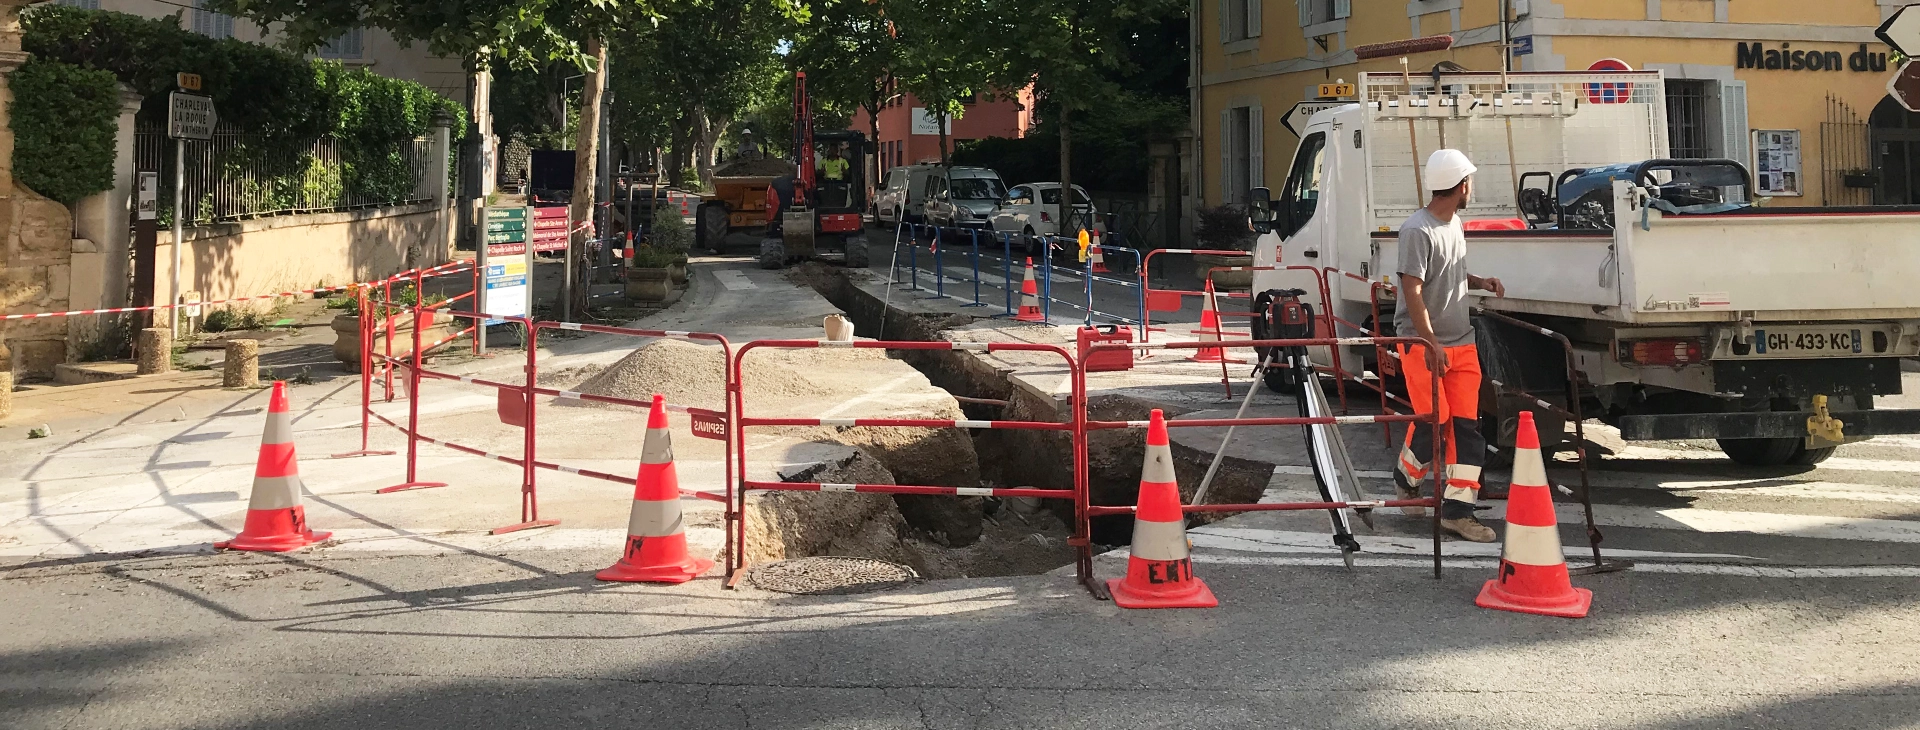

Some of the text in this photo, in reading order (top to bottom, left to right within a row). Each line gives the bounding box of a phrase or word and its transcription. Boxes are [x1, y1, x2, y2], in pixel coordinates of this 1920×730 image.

[1737, 42, 1887, 72] Maison du
[190, 76, 199, 88] 67
[1323, 86, 1349, 95] D 67
[175, 97, 211, 112] CHARLEVAL
[174, 111, 207, 125] LA ROQUE
[1768, 333, 1850, 350] GH-433-KC
[1853, 342, 1861, 351] 13
